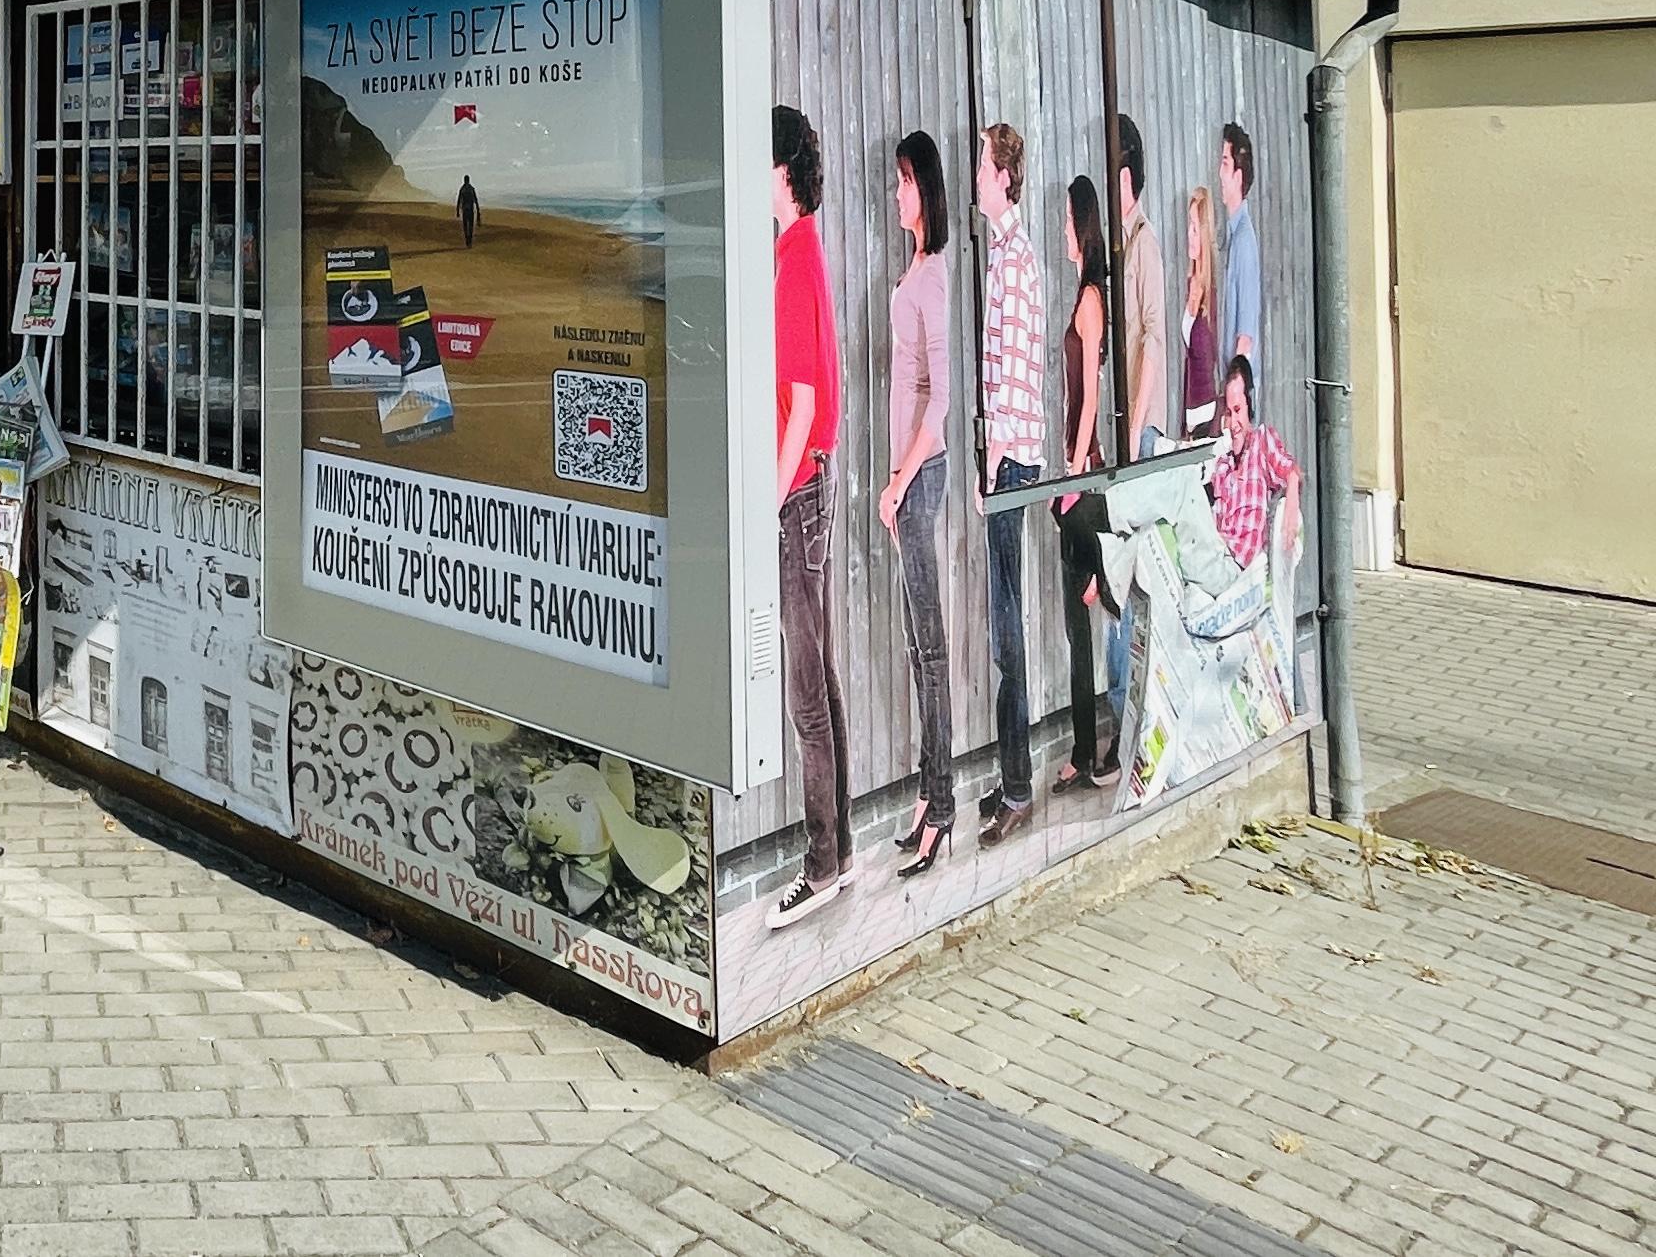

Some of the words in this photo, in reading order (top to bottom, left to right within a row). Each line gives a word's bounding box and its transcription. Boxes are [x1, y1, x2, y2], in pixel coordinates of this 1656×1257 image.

[326, 21, 359, 68] ZA
[369, 6, 438, 65] SVĚT
[450, 2, 528, 58] BEZE
[362, 71, 446, 95] NEDOPALKY
[454, 64, 500, 89] PATŘÍ
[509, 66, 530, 85] DO
[539, 60, 583, 83] KOŠE
[554, 324, 606, 343] NÁSLEDUJ
[568, 348, 574, 361] A
[577, 349, 631, 367] NASKENUJ
[315, 462, 424, 537] MINISTERSTVO
[428, 486, 572, 564] ZDRAVOTNICTVÍ
[575, 516, 663, 588] VARUJE:
[312, 525, 392, 593] KOUŘENÍ
[398, 542, 523, 628] ZPŮSOBUJE
[530, 577, 664, 665] RAKOVINU.
[298, 807, 387, 875] Krámek
[393, 856, 440, 900] pod
[446, 872, 504, 927] Věží
[511, 907, 543, 946] ul.
